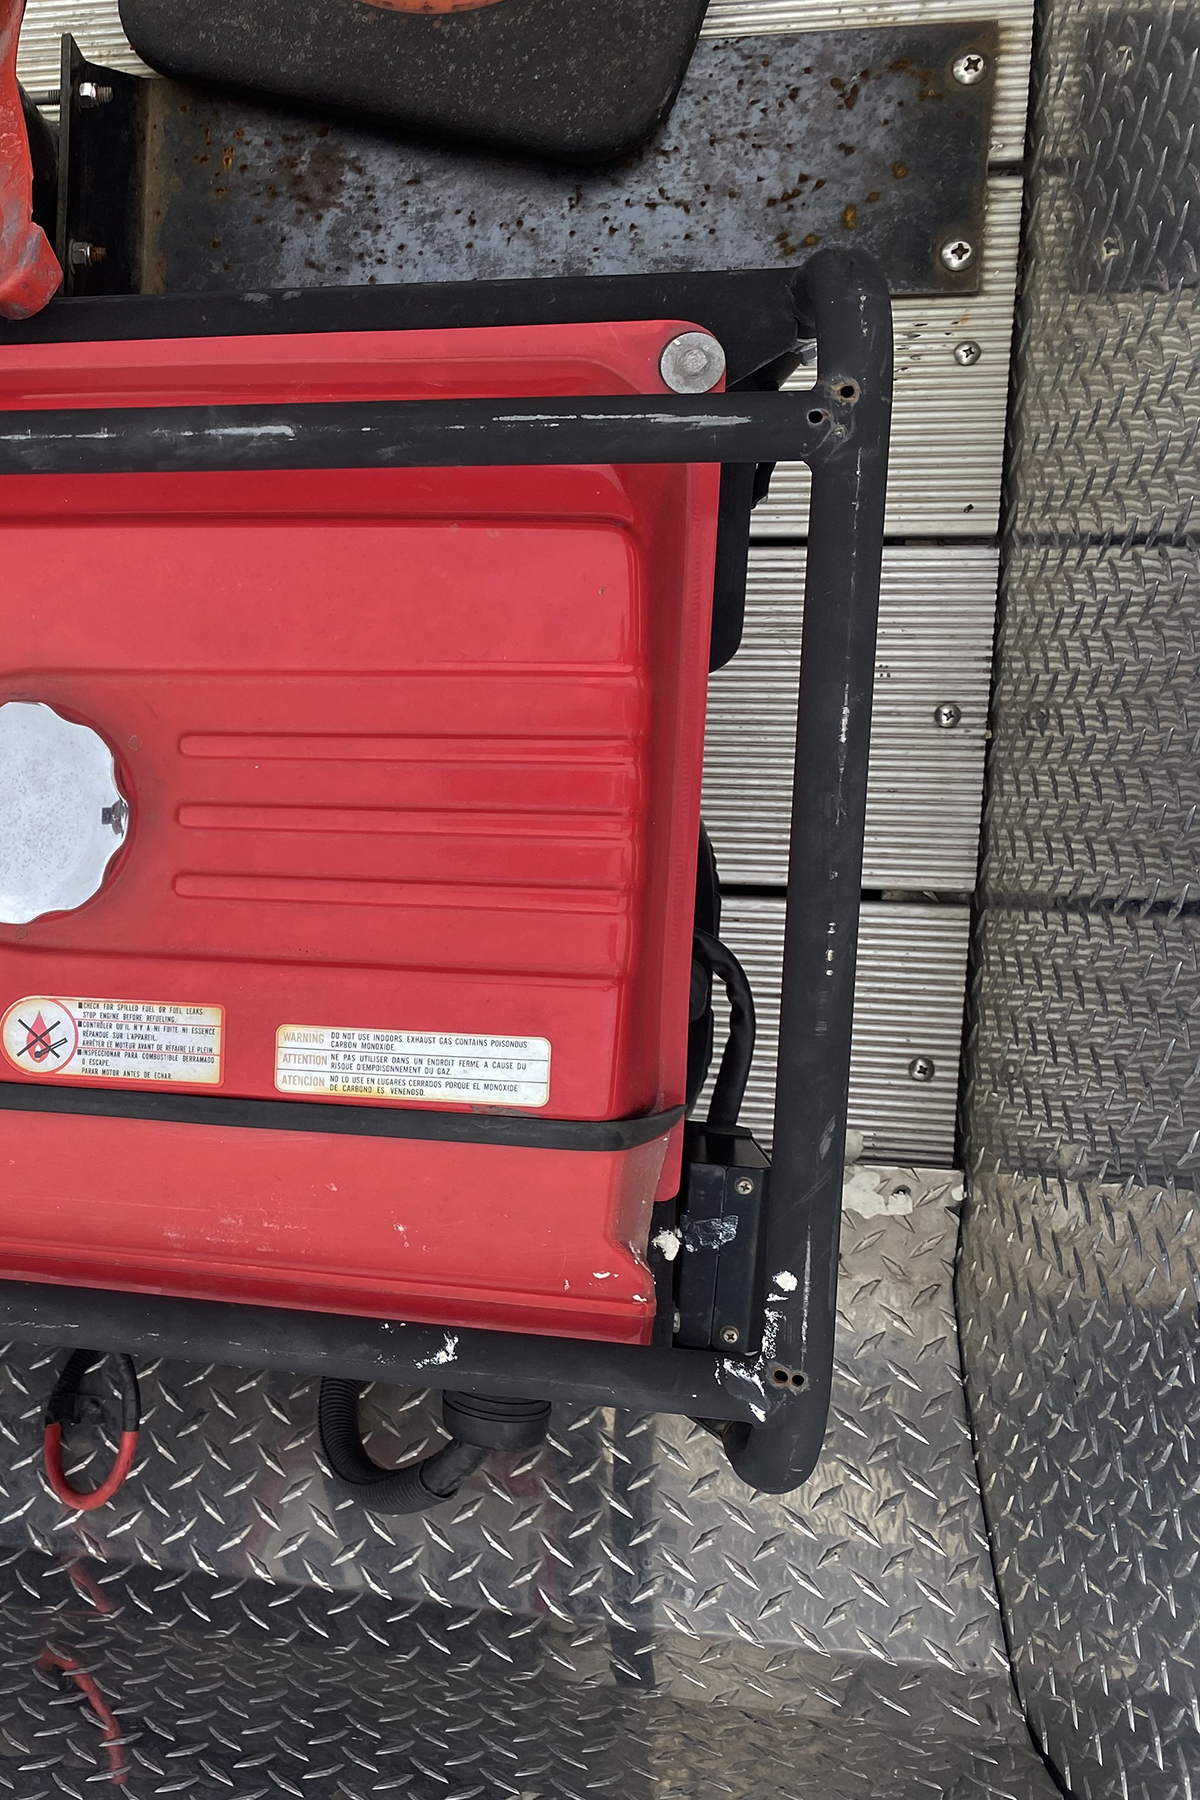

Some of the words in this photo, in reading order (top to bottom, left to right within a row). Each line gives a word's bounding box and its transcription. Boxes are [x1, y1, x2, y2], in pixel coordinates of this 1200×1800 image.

[283, 1032, 324, 1044] WARNING
[407, 1036, 436, 1044] EXHAUST
[439, 1037, 452, 1045] GAS
[455, 1038, 488, 1047] CONTAINS
[491, 1040, 528, 1048] POISONOUS
[331, 1041, 357, 1049] CARBON
[142, 1052, 178, 1061] COMBUSTIBLE
[283, 1053, 327, 1065] ATTENTION
[343, 1054, 355, 1062] PAS
[360, 1055, 388, 1063] UTILISER
[392, 1056, 410, 1065] DANS
[414, 1057, 423, 1065] UN
[427, 1058, 454, 1067] ENDROIT
[492, 1061, 513, 1070] CAUSE
[331, 1063, 353, 1071] RISQUE
[282, 1075, 325, 1087] ATENCION
[367, 1077, 375, 1085] EN
[378, 1078, 406, 1087] LUGARES
[408, 1079, 442, 1088] CERRADOS
[445, 1081, 469, 1090] PORQUE
[484, 1083, 518, 1092] MONOXIDE
[343, 1085, 372, 1093] CARBONO
